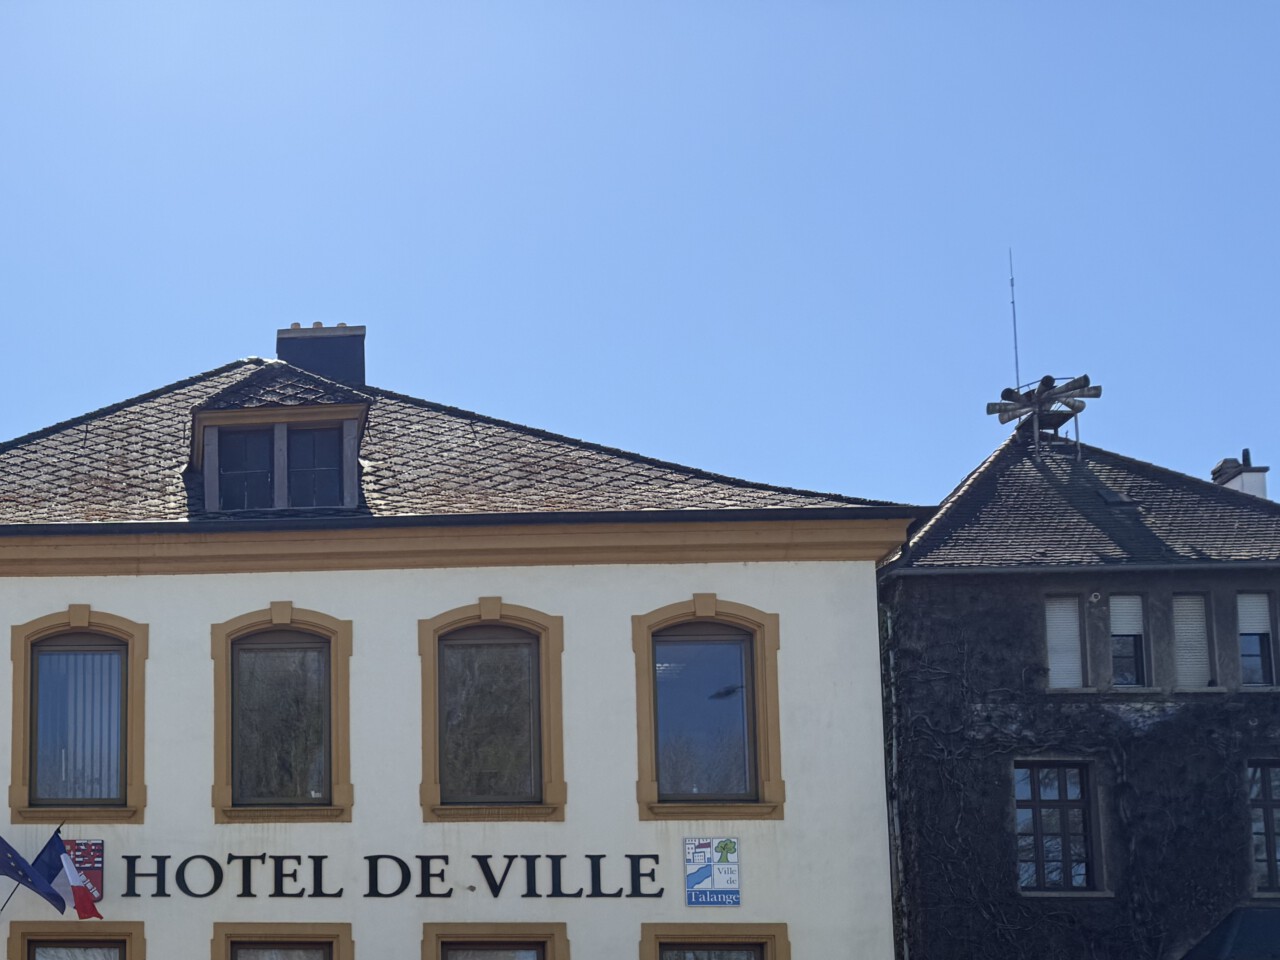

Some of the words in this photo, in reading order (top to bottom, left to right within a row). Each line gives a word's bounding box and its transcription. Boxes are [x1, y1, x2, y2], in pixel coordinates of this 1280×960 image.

[121, 853, 344, 898] HOTEL
[363, 855, 453, 898] DE
[472, 855, 664, 898] VILLE
[717, 867, 737, 875] Ville
[726, 877, 737, 885] de
[687, 891, 740, 905] Talange
